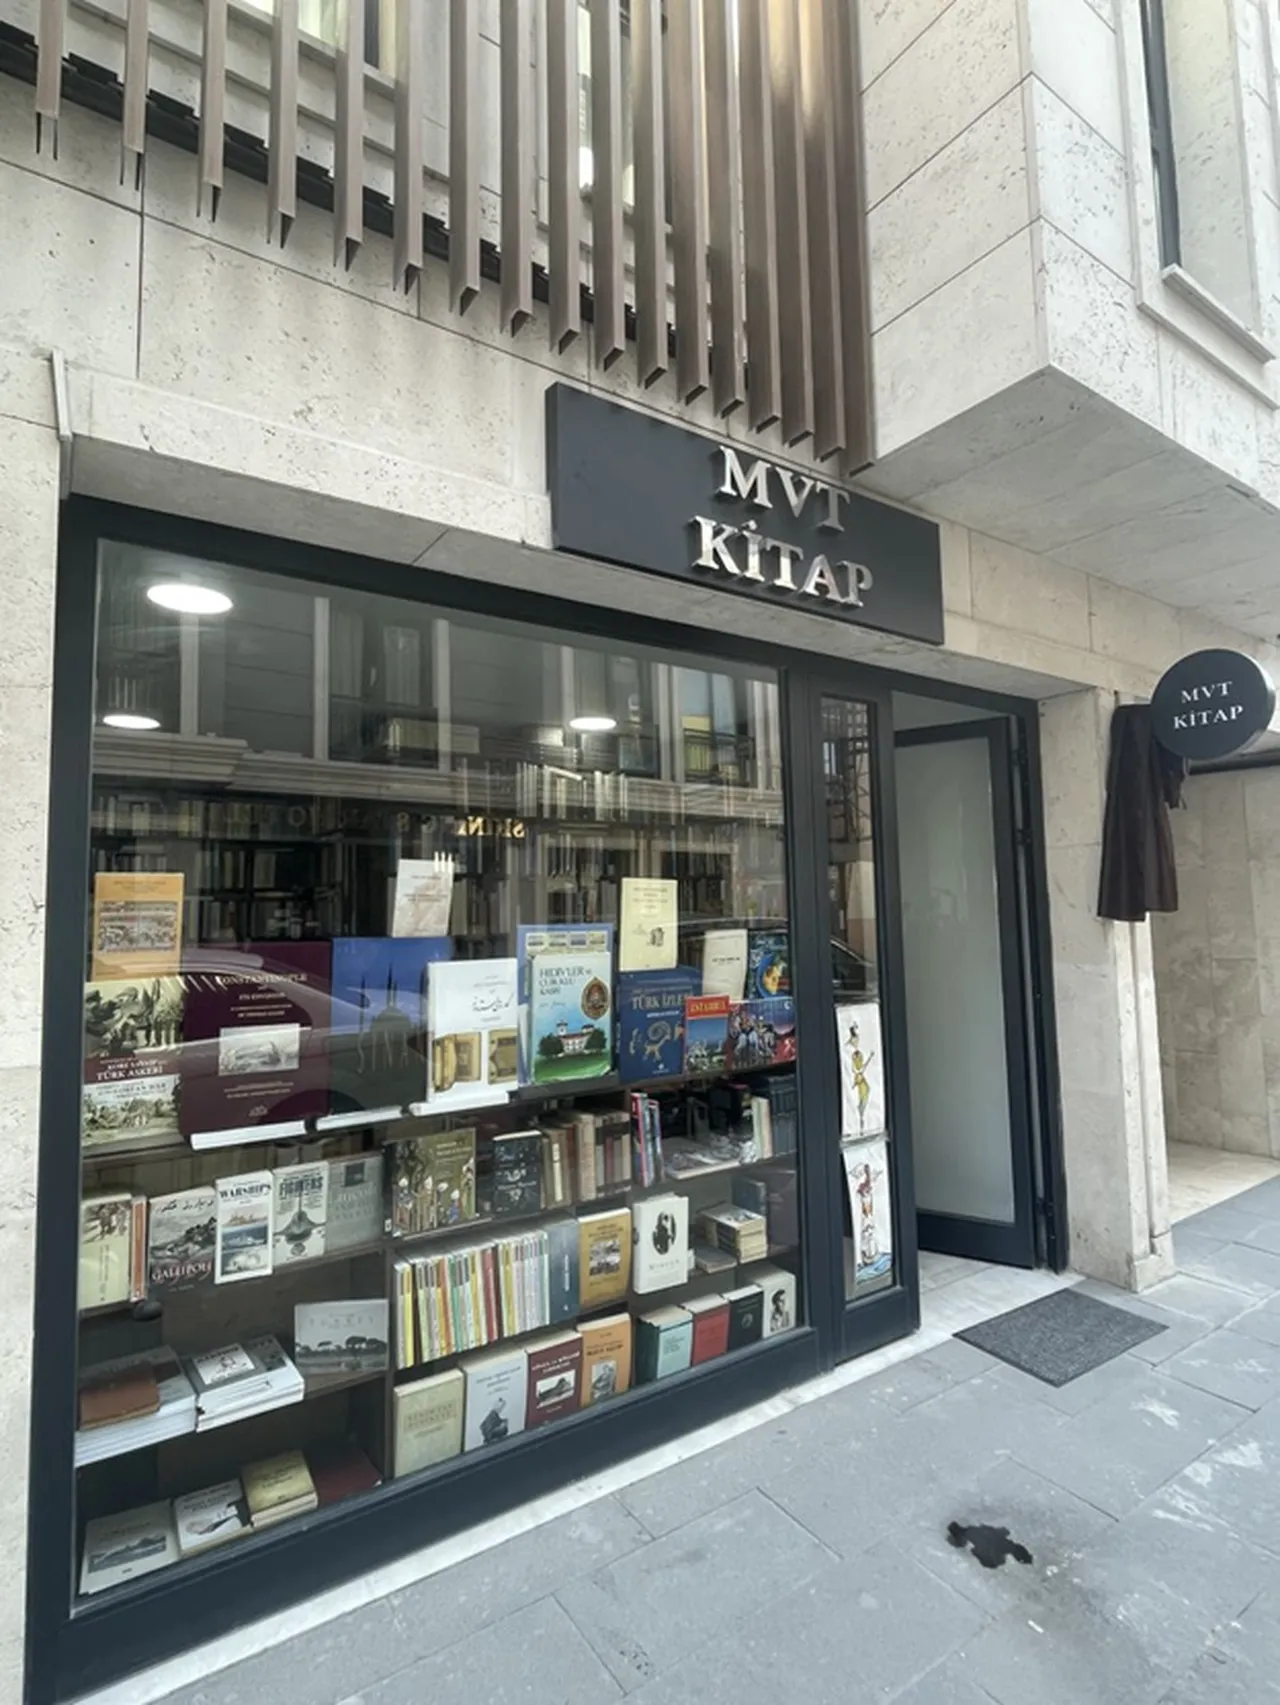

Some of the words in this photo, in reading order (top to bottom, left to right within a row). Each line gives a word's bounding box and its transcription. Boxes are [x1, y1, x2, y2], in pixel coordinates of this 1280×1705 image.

[714, 444, 851, 533] MVT
[688, 514, 874, 608] KİTAP
[1173, 704, 1244, 729] KİTAP
[1181, 681, 1233, 704] MVT
